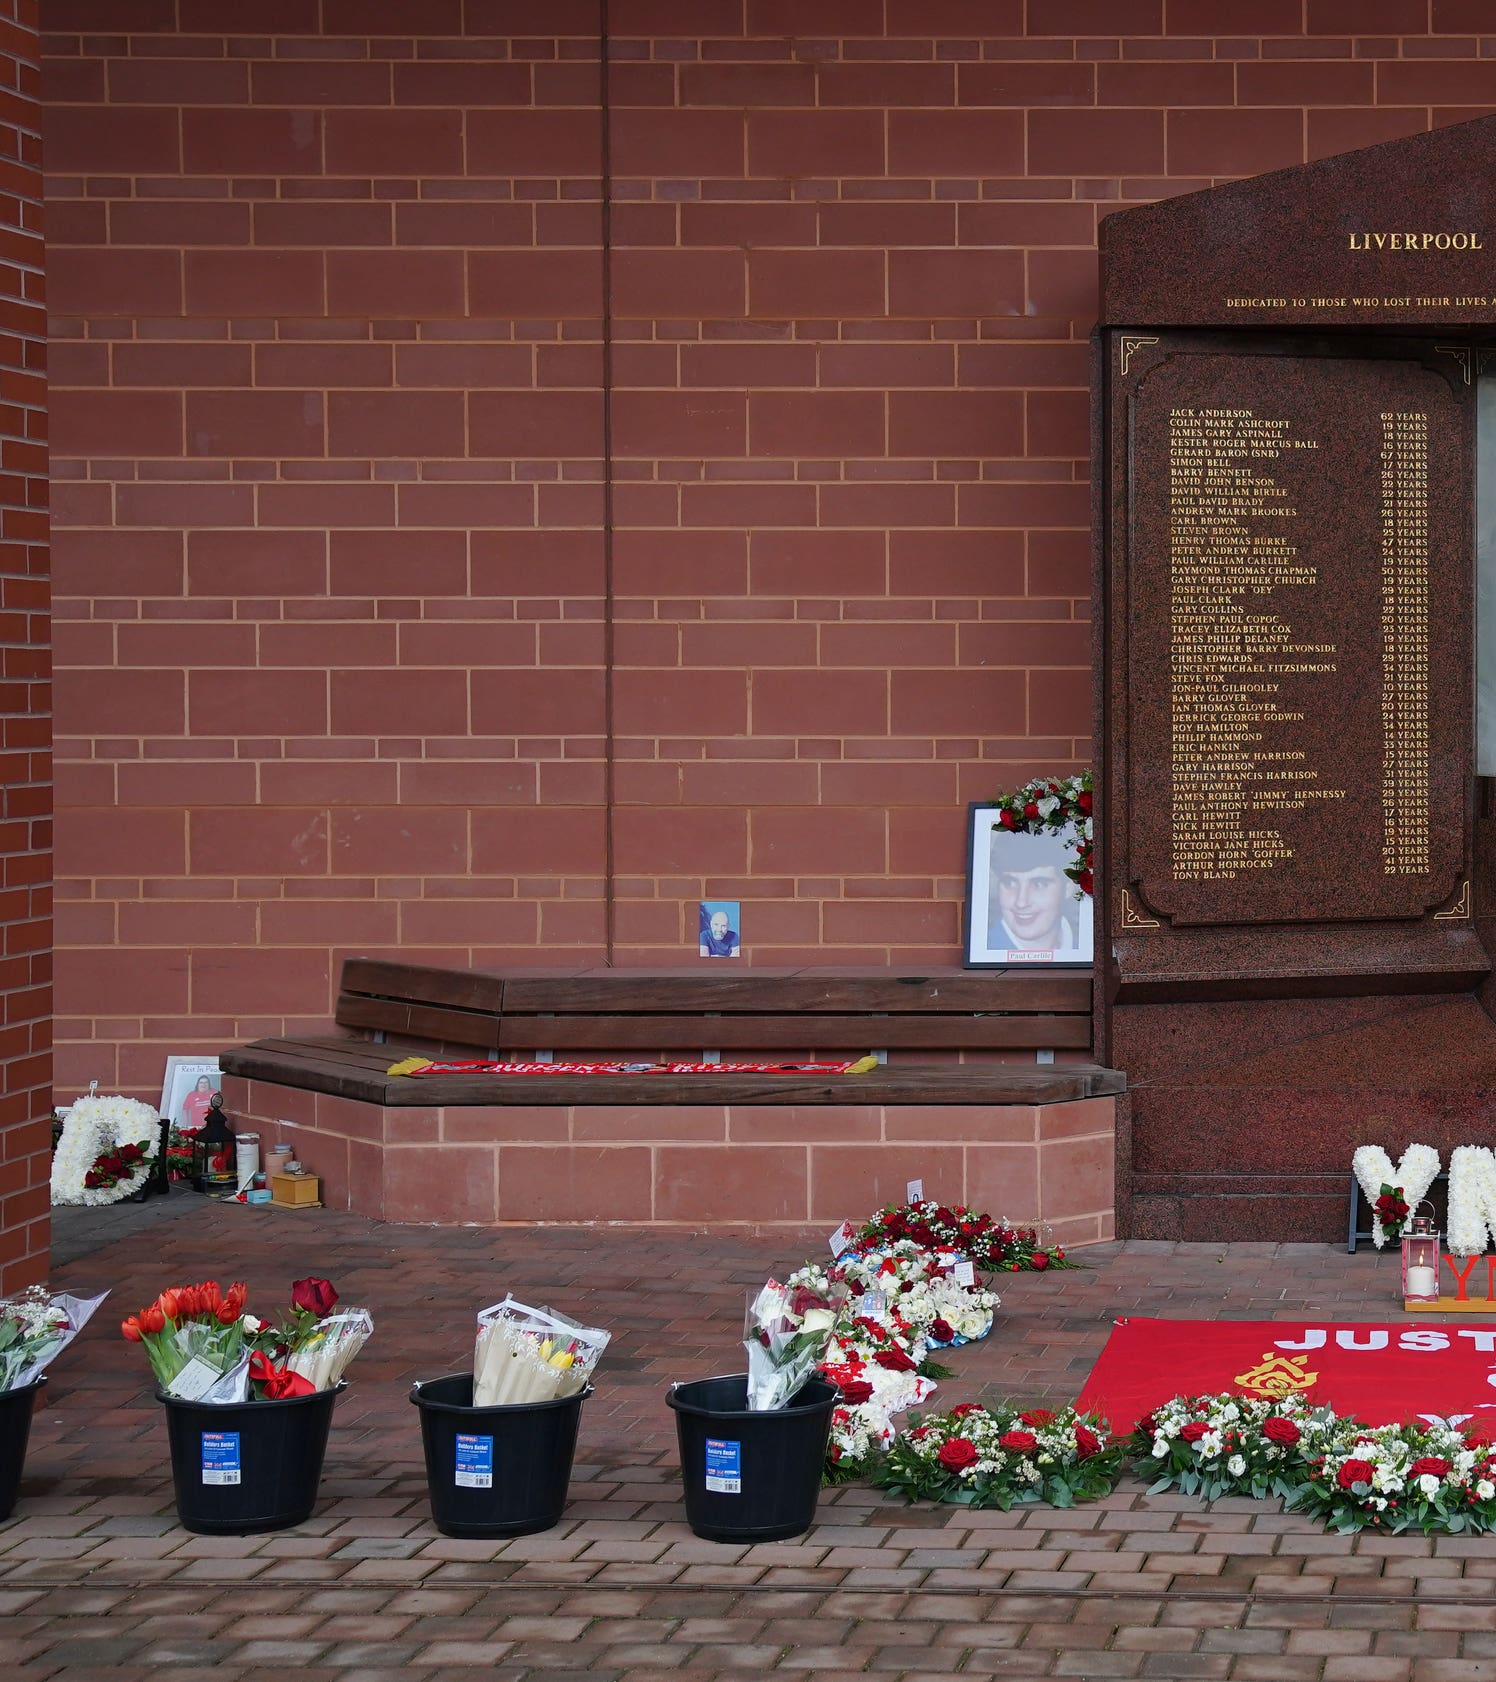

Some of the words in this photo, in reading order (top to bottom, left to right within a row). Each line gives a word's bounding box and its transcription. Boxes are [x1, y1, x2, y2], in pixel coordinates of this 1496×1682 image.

[1349, 233, 1482, 250] LIVERPOOL
[1292, 298, 1306, 307] TO
[1311, 298, 1346, 307] THOSE
[1352, 298, 1379, 307] WHO
[1384, 298, 1410, 306] LOST
[1416, 297, 1450, 306] THEIR
[1456, 297, 1486, 306] LIVES
[1170, 409, 1195, 417] JACK
[1199, 409, 1252, 418] ANDERSON
[1380, 413, 1393, 421] 62
[1396, 413, 1427, 421] YEARS
[1171, 438, 1208, 447] KESTER
[1213, 439, 1246, 447] ROGER
[1250, 440, 1291, 448] MARCUS
[1397, 442, 1427, 450] YEARS
[1171, 477, 1201, 485] DAVID
[1204, 478, 1231, 486] JOHN
[1235, 478, 1274, 486] BENSON
[1382, 480, 1394, 488] 22
[1397, 480, 1428, 488] YEARS
[1209, 537, 1251, 545] THOMAS
[1254, 537, 1287, 545] BURKE
[1381, 538, 1394, 546] 47
[1397, 538, 1428, 546] YEARS
[1171, 605, 1198, 613] GARY
[1201, 605, 1244, 613] COLLINS
[1171, 645, 1241, 653] CHRISTOPHER
[1246, 645, 1278, 653] BARRY
[1397, 644, 1428, 652] YEARS
[1222, 684, 1279, 692] GILHOOLEY
[1383, 683, 1394, 691] 10
[1397, 683, 1428, 691] YEARS
[1172, 724, 1192, 732] ROY
[1197, 723, 1249, 731] HAMILTON
[1397, 721, 1428, 729] YEARS
[1172, 773, 1216, 781] STEPHEN
[1220, 772, 1263, 780] FRANCIS
[1266, 771, 1318, 779] HARRISON
[1385, 770, 1394, 778] 31
[1397, 769, 1428, 777] YEARS
[1172, 832, 1205, 840] SARAH
[1209, 831, 1245, 839] LOUISE
[1249, 830, 1280, 838] HICKS
[1384, 828, 1395, 836] 19
[1398, 827, 1429, 835] YEARS
